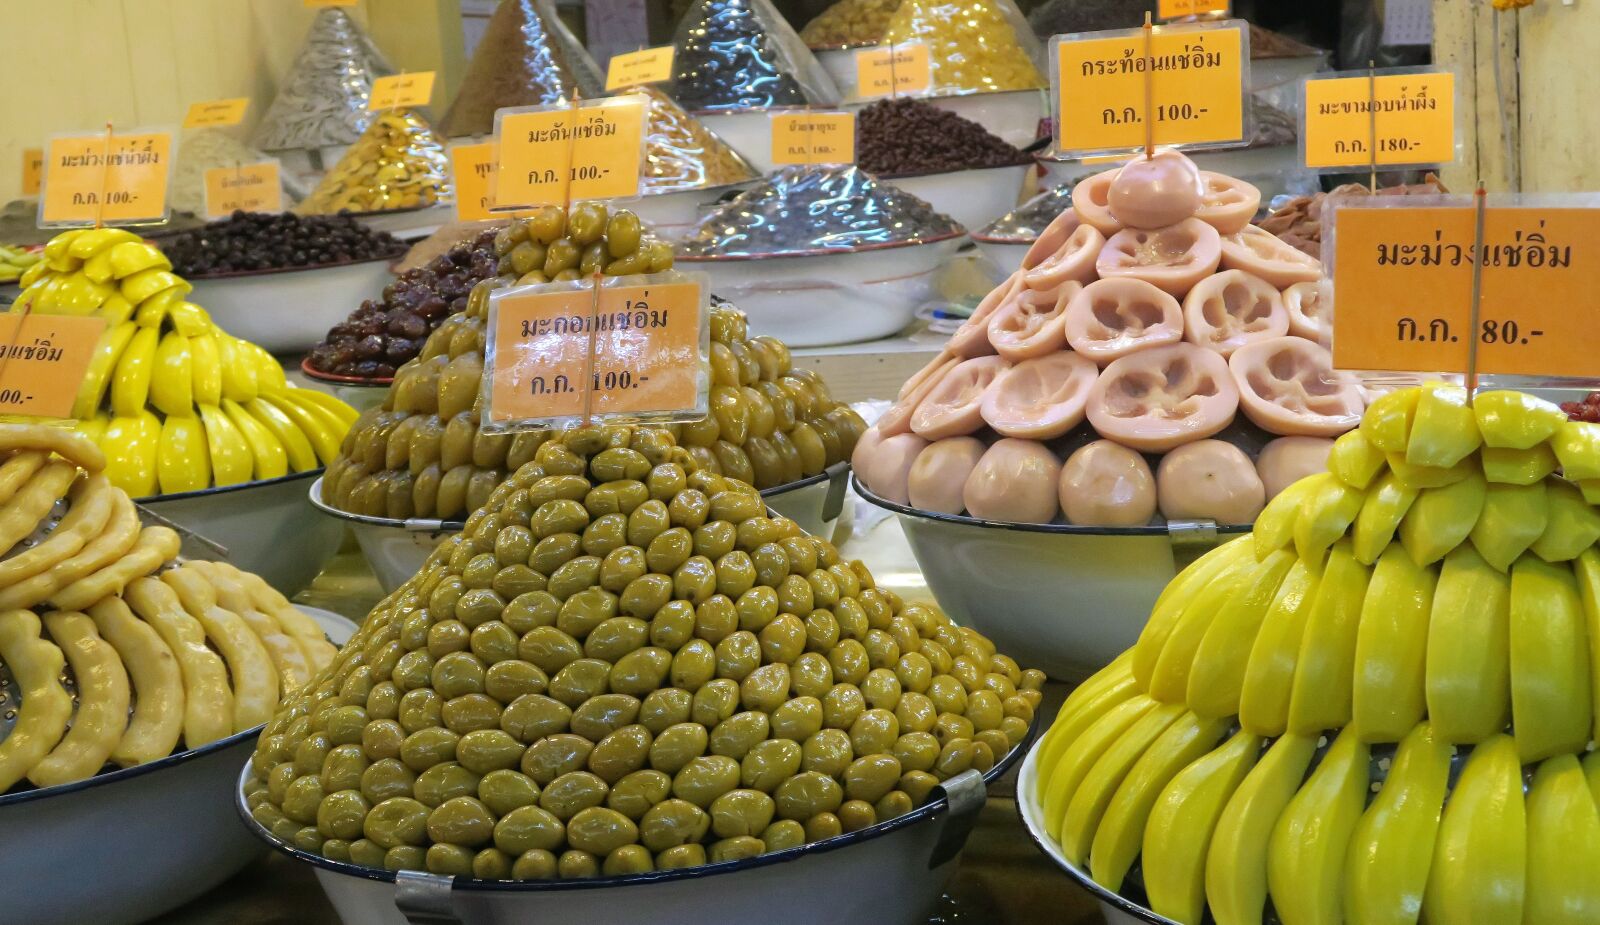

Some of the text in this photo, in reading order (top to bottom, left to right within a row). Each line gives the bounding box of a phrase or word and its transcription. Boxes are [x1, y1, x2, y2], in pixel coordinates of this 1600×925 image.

[1081, 36, 1220, 76] กระท้อนแช่อิ่ม
[1319, 85, 1436, 115] มะขามอบน้ำผึ้ง
[528, 110, 616, 143] มะดันแช่อิ่ม
[1102, 103, 1208, 125] ก.ก. 100.-
[1335, 138, 1420, 153] ก.ก. 180.-
[528, 165, 610, 184] ก.ก. 100.-
[73, 191, 139, 205] ก.ก. 100.-
[521, 290, 668, 338] มะกอกแช่อิ่ม
[1397, 317, 1544, 345] ก.ก. 80.-
[531, 370, 649, 395] ก.ก. 100.-
